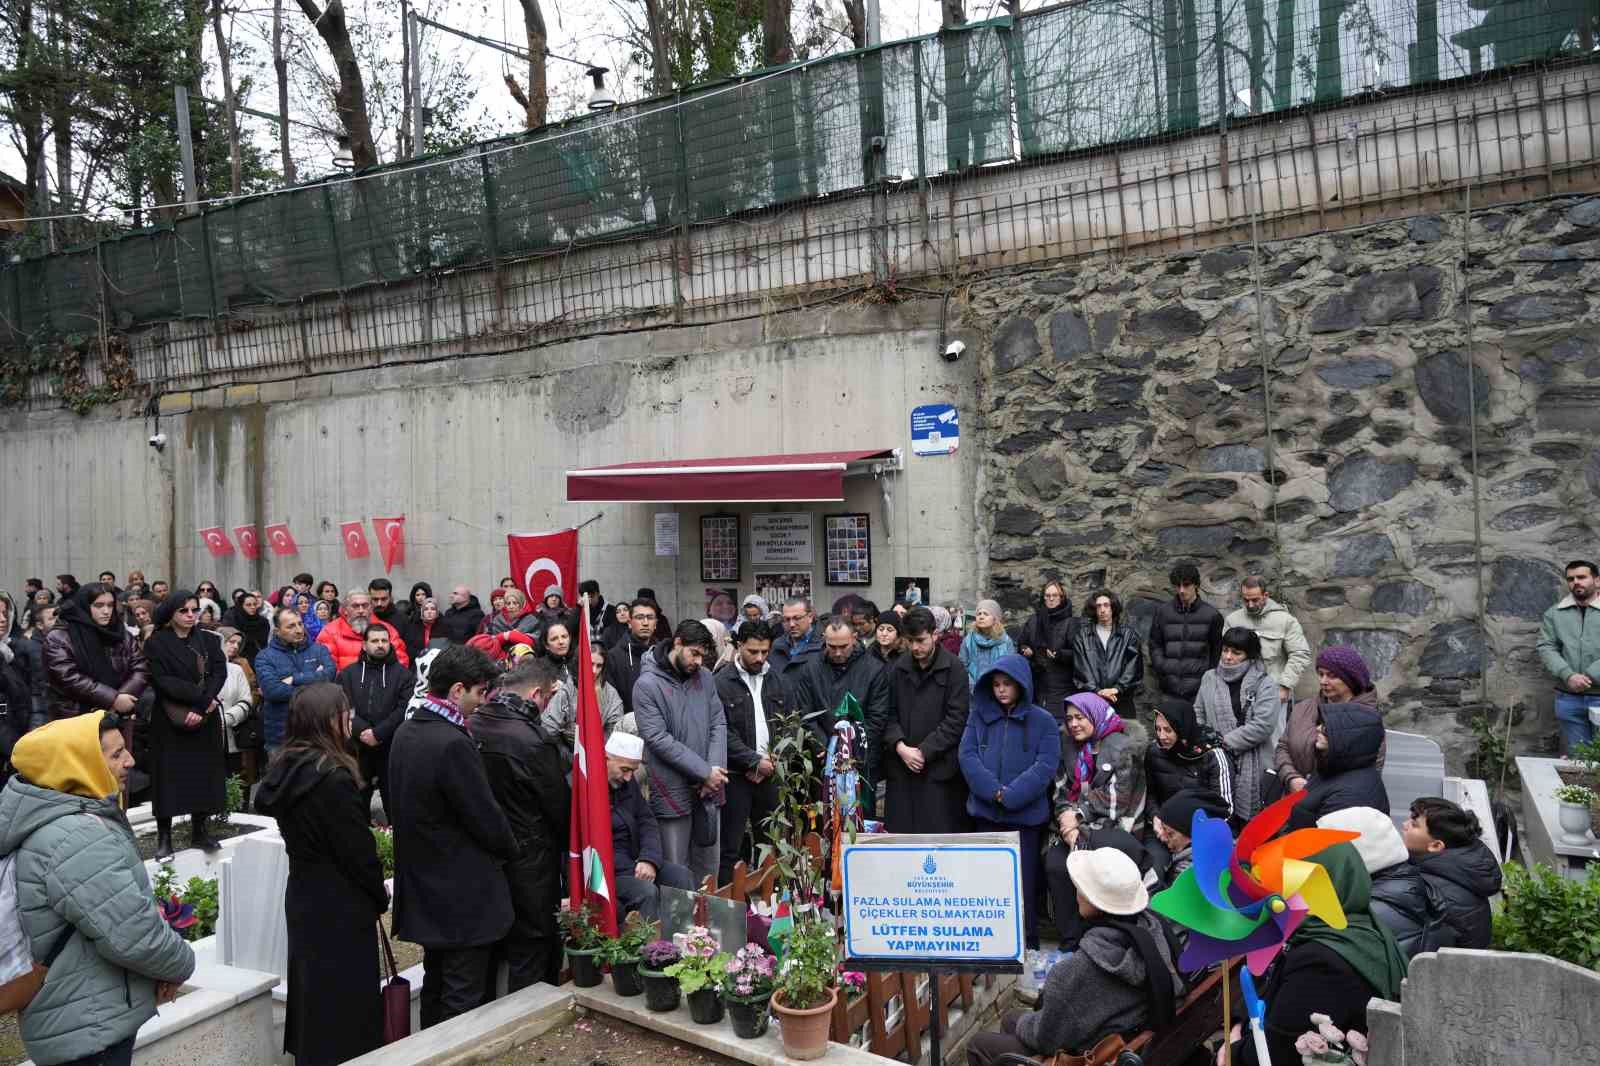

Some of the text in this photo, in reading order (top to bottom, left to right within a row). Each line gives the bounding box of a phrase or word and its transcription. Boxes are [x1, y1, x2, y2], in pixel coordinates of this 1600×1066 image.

[853, 896, 1011, 907] FAZLA SULAMA NEDENİYLE
[859, 908, 1005, 919] ÇİÇEKLER SOLMAKTADIR
[872, 923, 994, 937] LÜTFEN SULAMA
[886, 940, 980, 952] YAPMAYINIZ!
